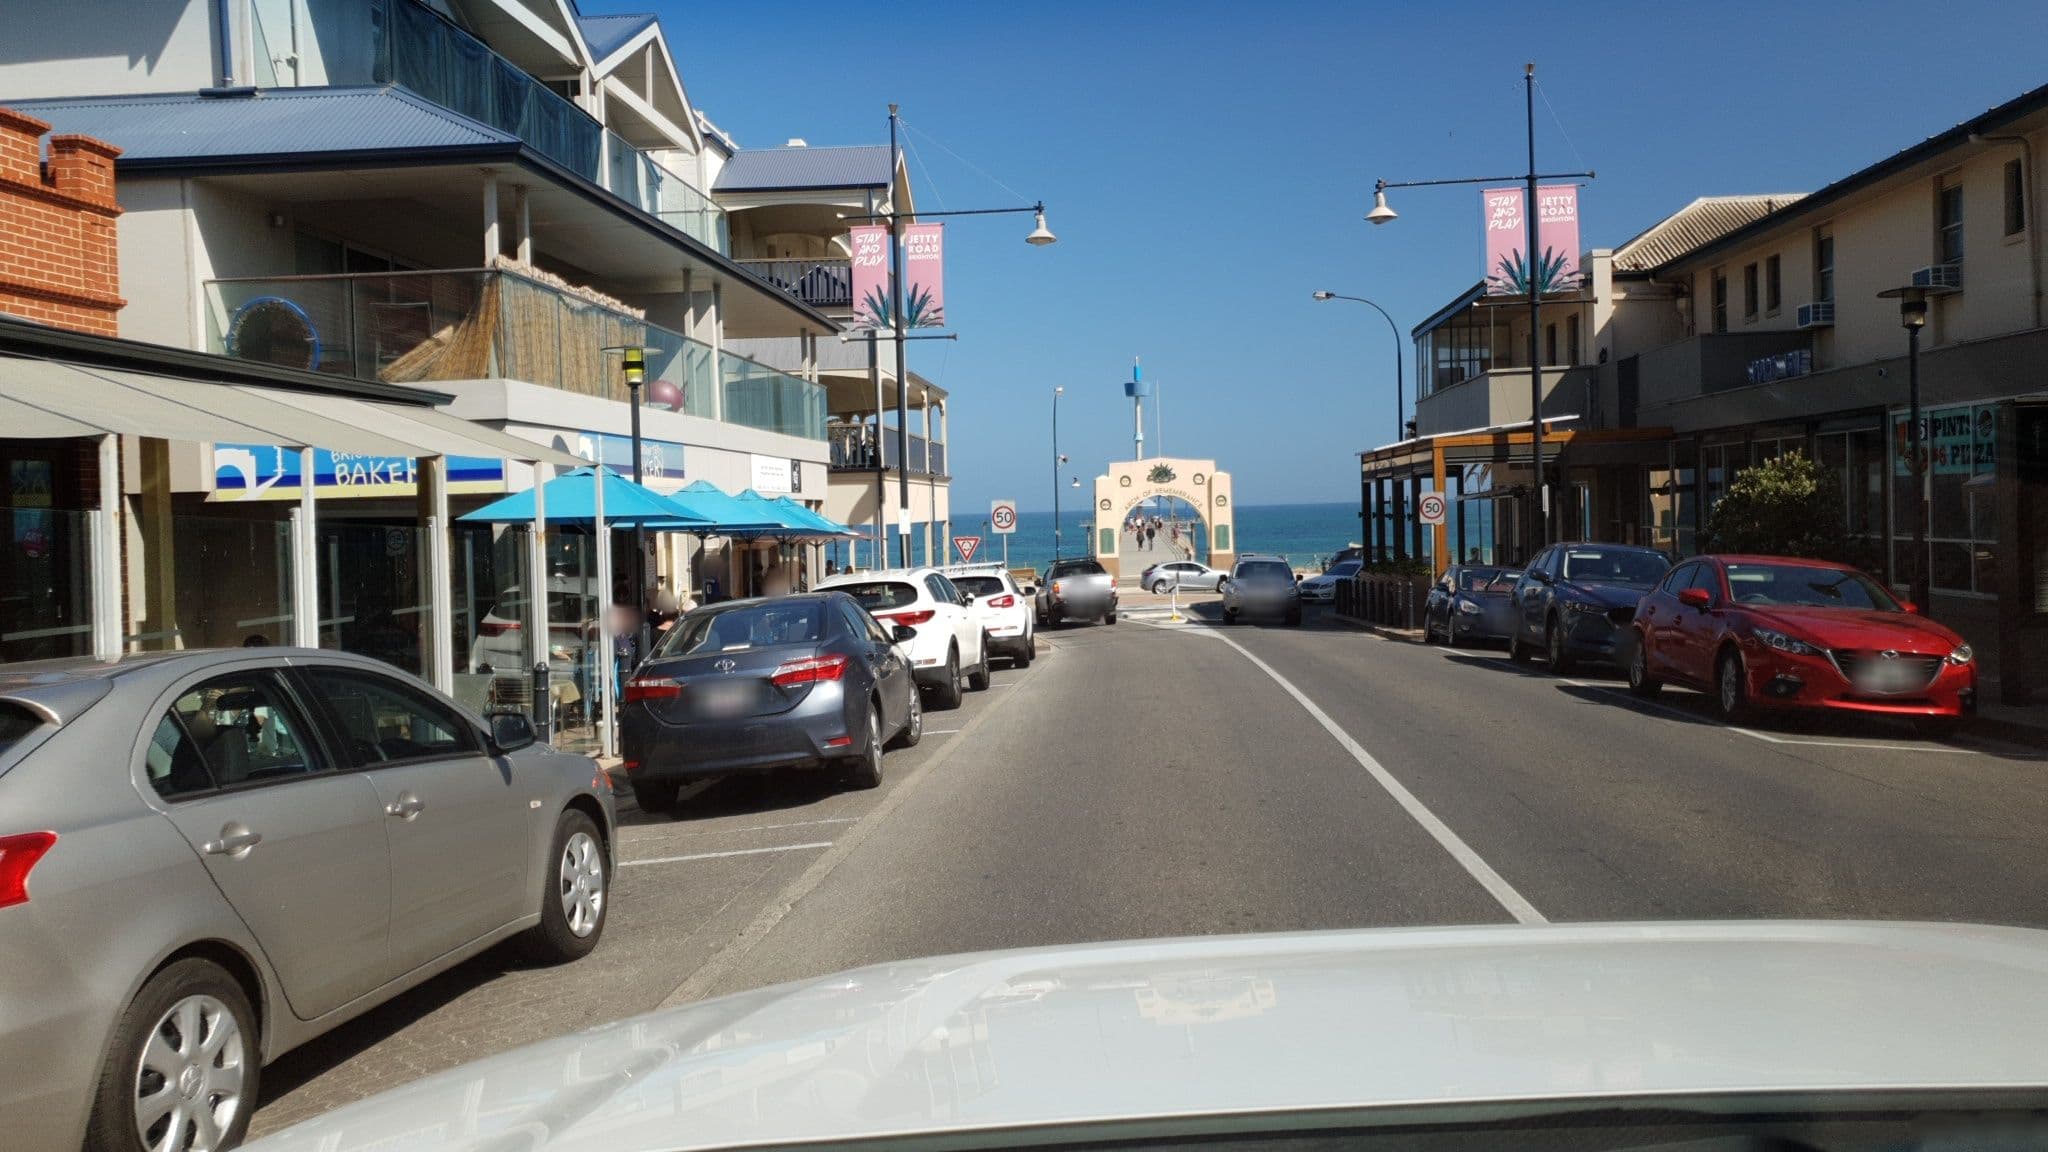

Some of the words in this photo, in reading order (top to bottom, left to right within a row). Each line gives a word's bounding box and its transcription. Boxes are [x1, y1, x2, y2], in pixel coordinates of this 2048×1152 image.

[1488, 195, 1518, 207] STAY
[1541, 196, 1573, 206] JETTY
[1492, 207, 1516, 219] AND
[1540, 206, 1574, 216] ROAD
[1488, 217, 1521, 231] PLAY
[856, 233, 882, 244] STAY
[908, 234, 939, 244] JETTY
[857, 245, 881, 256] AND
[908, 245, 939, 253] ROAD
[854, 255, 886, 268] PLAY
[1425, 502, 1440, 513] 50
[996, 512, 1012, 523] 50
